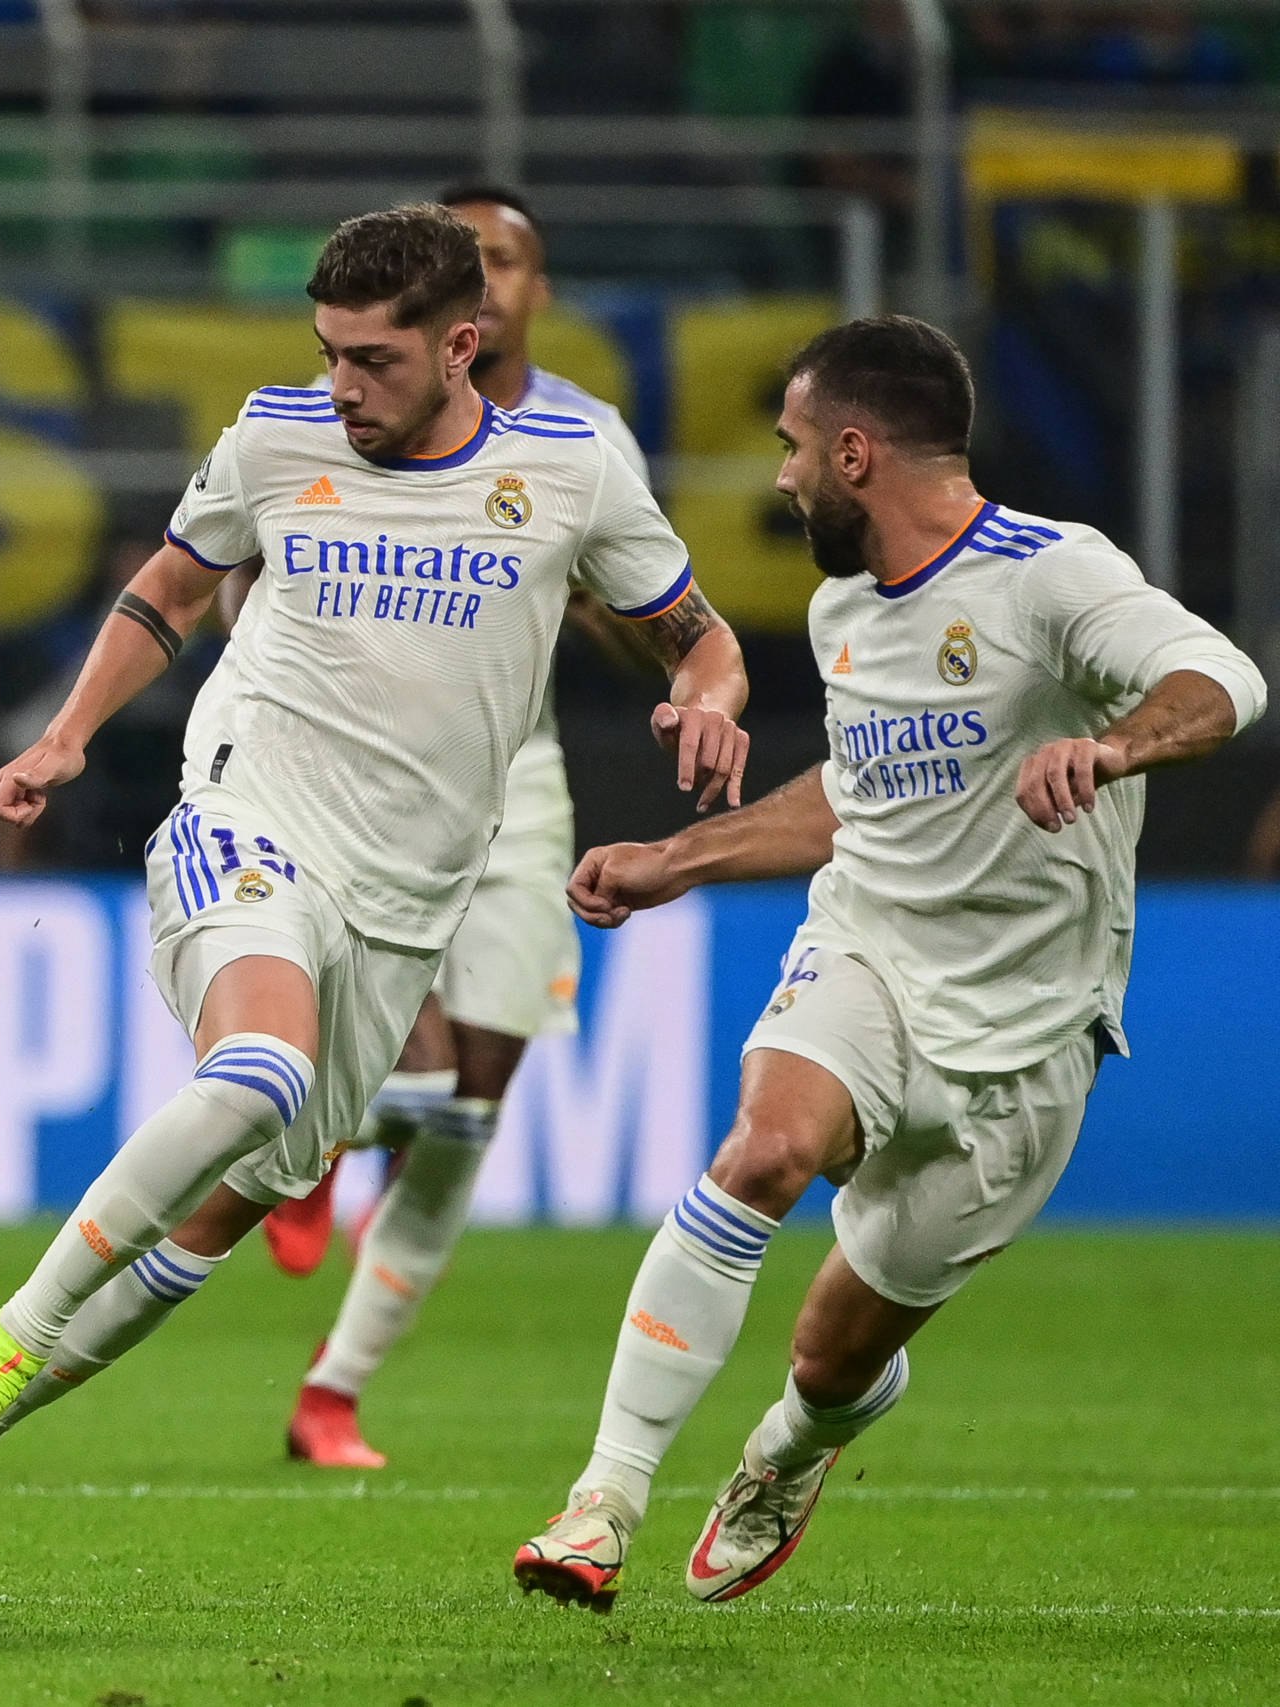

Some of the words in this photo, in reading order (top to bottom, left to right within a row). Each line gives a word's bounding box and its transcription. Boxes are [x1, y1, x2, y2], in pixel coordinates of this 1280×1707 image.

[295, 495, 342, 505] adidas
[283, 533, 522, 590] Emirates
[316, 581, 365, 617] FLY
[373, 584, 482, 629] BETTER
[837, 708, 988, 763] mirates
[878, 757, 967, 799] BETTER
